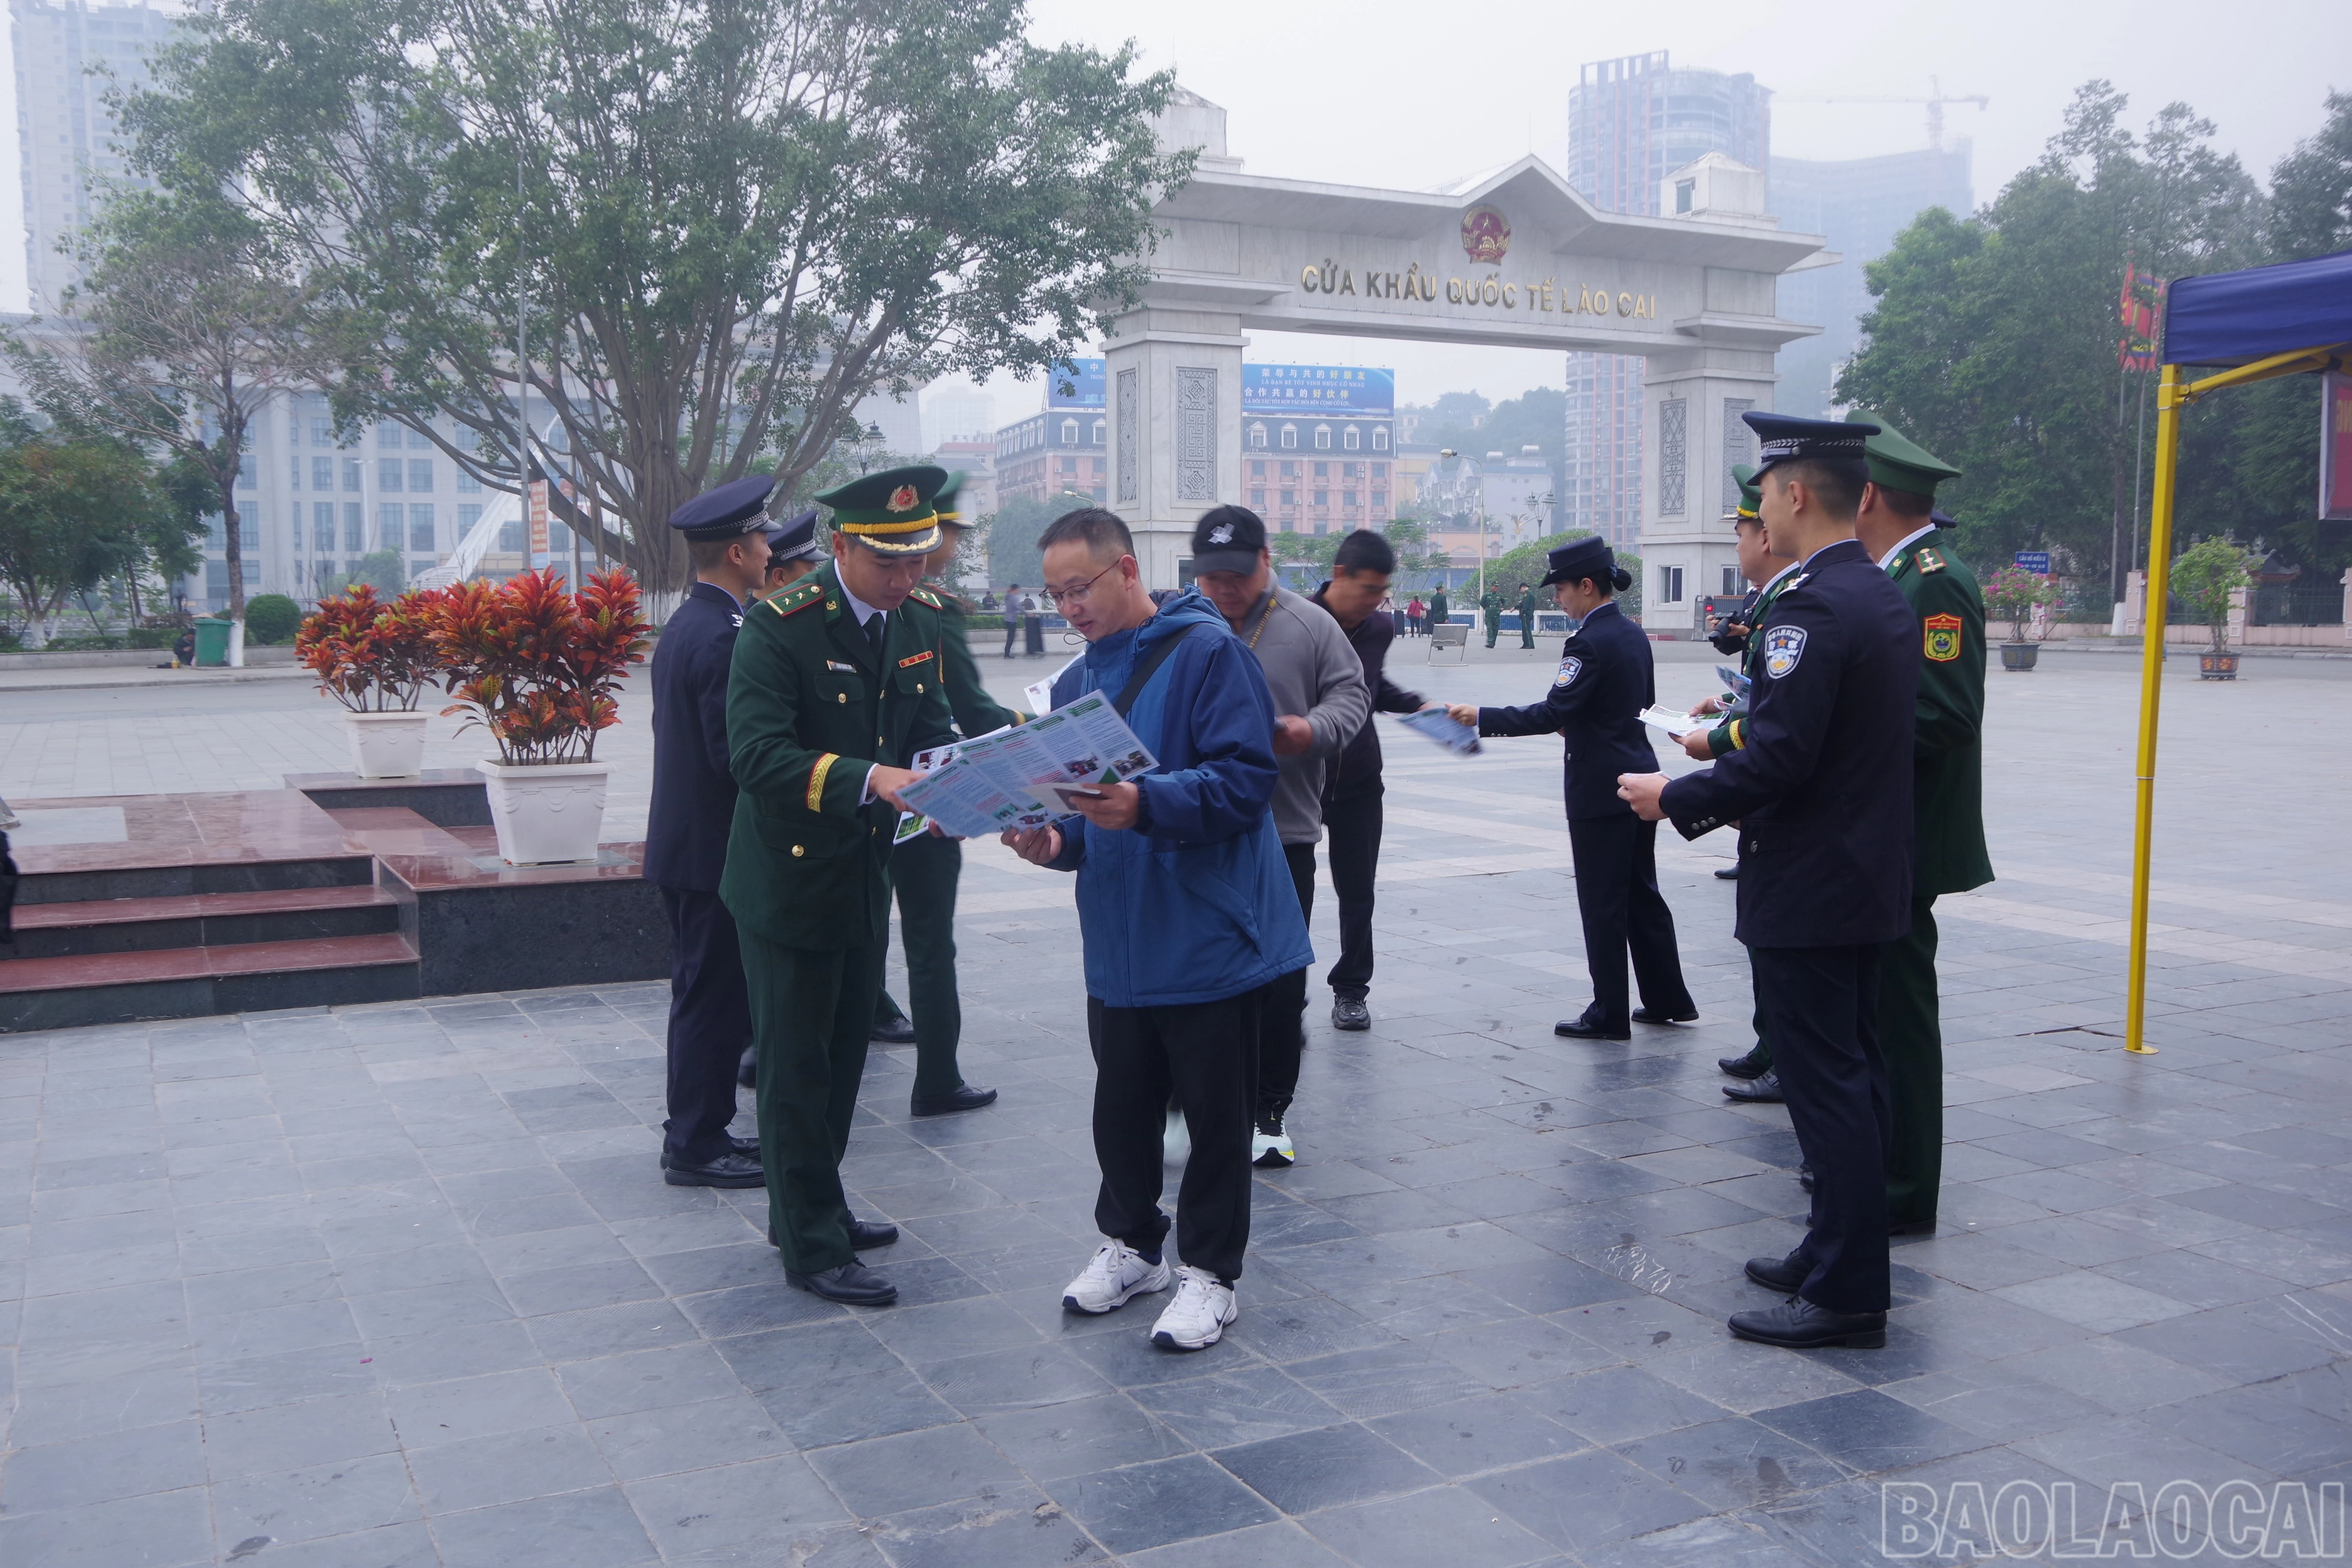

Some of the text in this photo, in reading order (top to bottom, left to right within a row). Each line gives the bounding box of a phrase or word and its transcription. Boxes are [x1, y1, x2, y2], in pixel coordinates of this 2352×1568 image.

[1302, 258, 1655, 319] CỬA KHẨU QUỐC TẾ LÀO CAI
[1261, 368, 1365, 380] 荣辱与共的好朋友
[1244, 387, 1349, 399] 合作共赢的好伙伴
